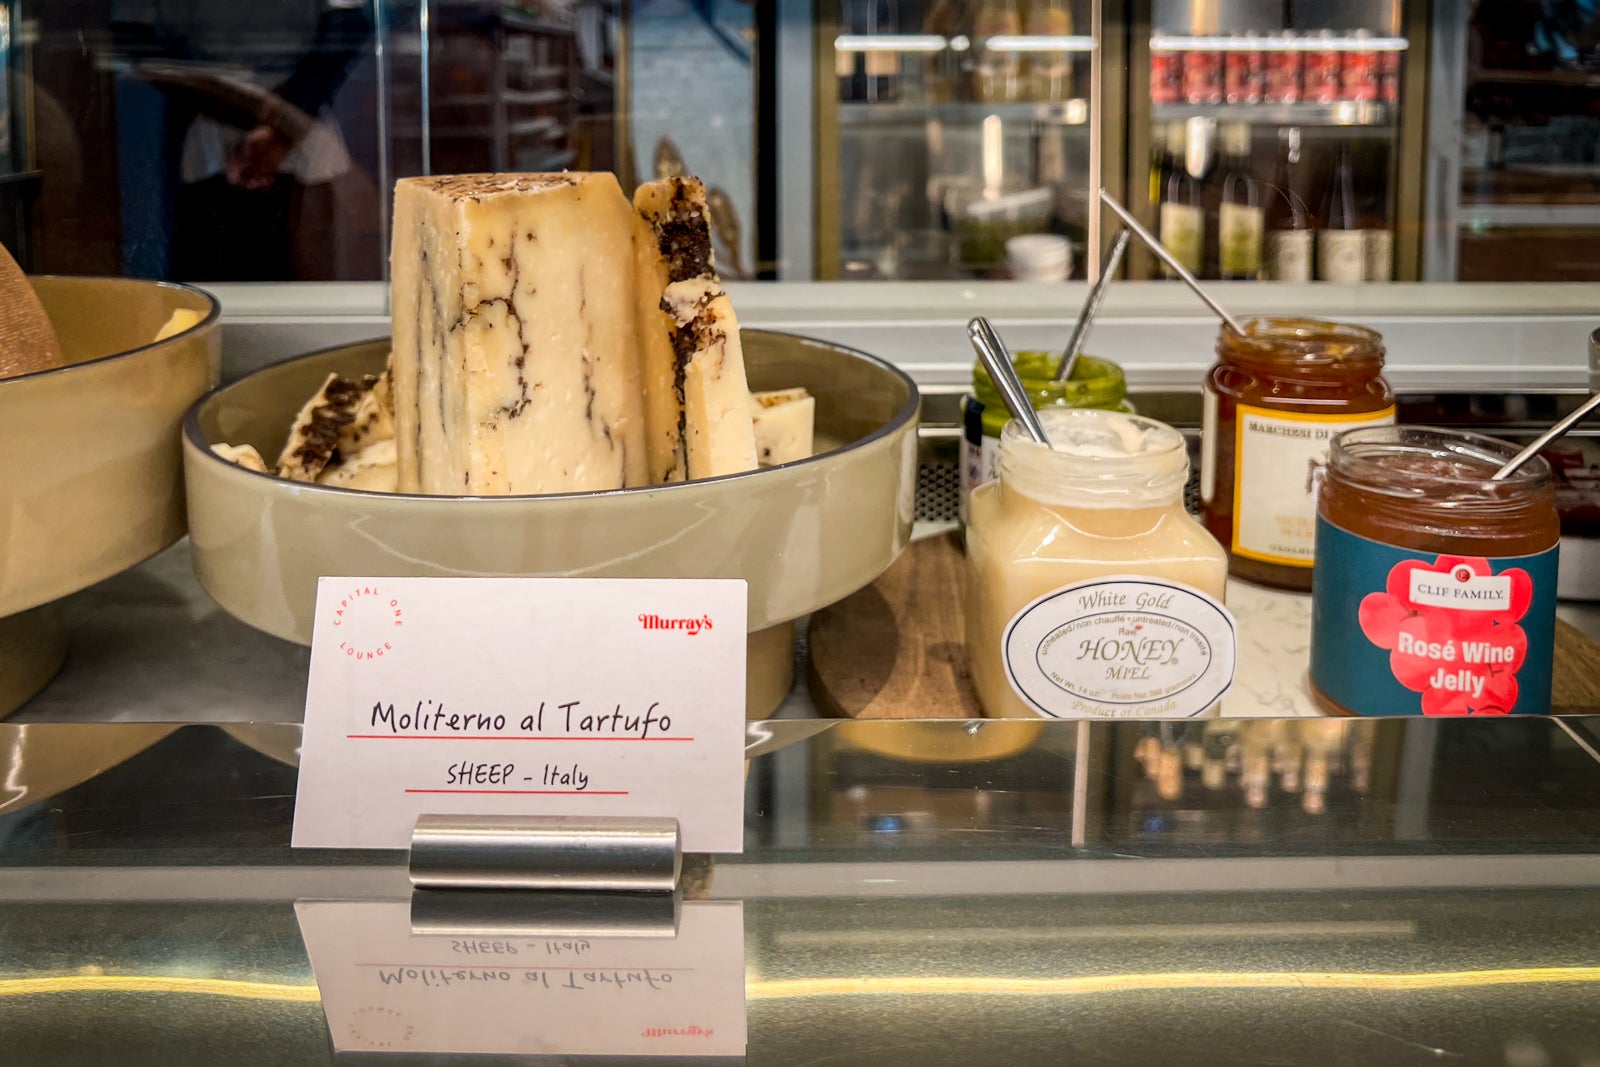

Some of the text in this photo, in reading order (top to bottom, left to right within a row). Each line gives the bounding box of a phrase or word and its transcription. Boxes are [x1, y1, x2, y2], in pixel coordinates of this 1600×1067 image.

[1078, 590, 1172, 610] White Gold
[1417, 583, 1449, 597] CLIF
[333, 587, 403, 626] CAPITAL ONE
[637, 613, 713, 637] Murray's
[339, 641, 392, 660] LOUNGE
[1397, 630, 1516, 664] Rosé Wine
[1105, 665, 1151, 680] MIEL
[1429, 667, 1486, 699] Jelly
[370, 700, 672, 740] Moliterno al Tartufo
[1071, 699, 1116, 717] Product
[446, 761, 515, 786] SHEEP
[542, 762, 589, 791] Italy
